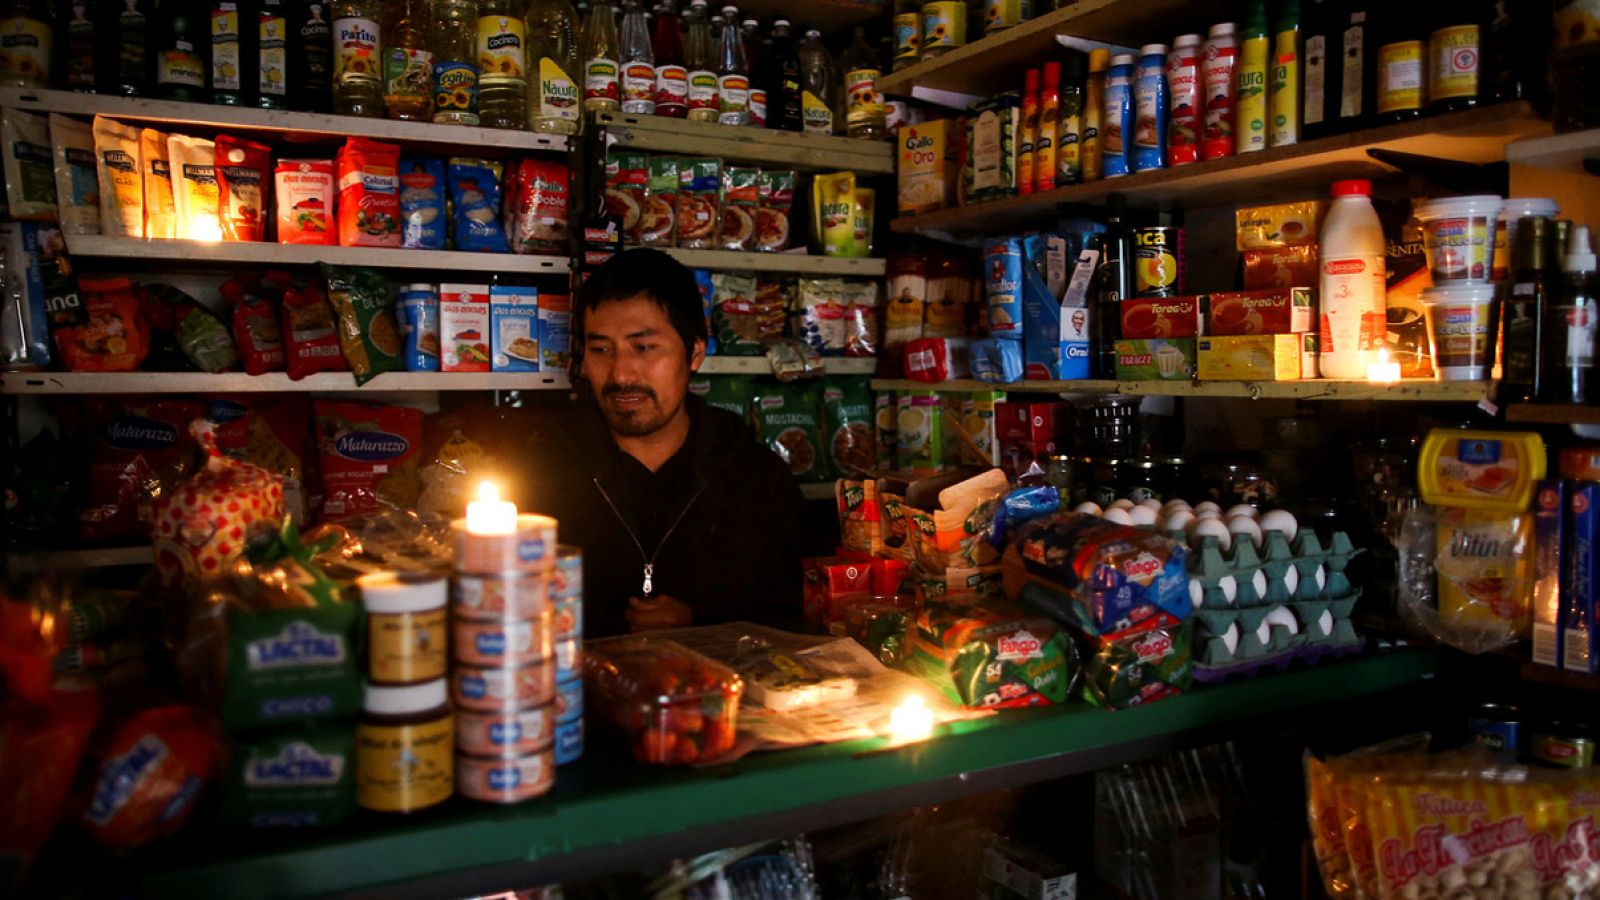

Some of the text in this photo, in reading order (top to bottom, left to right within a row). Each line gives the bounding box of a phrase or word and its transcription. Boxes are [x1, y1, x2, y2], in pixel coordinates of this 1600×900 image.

[542, 79, 578, 97] Natura
[912, 151, 936, 165] Oro
[534, 193, 566, 207] Doble
[106, 421, 176, 442] Matarazzo
[338, 437, 405, 453] Matarazzo
[258, 638, 337, 663] LACTAL
[1000, 635, 1040, 657] Fargo
[1133, 636, 1170, 658] Fargo
[985, 663, 1001, 676] 54
